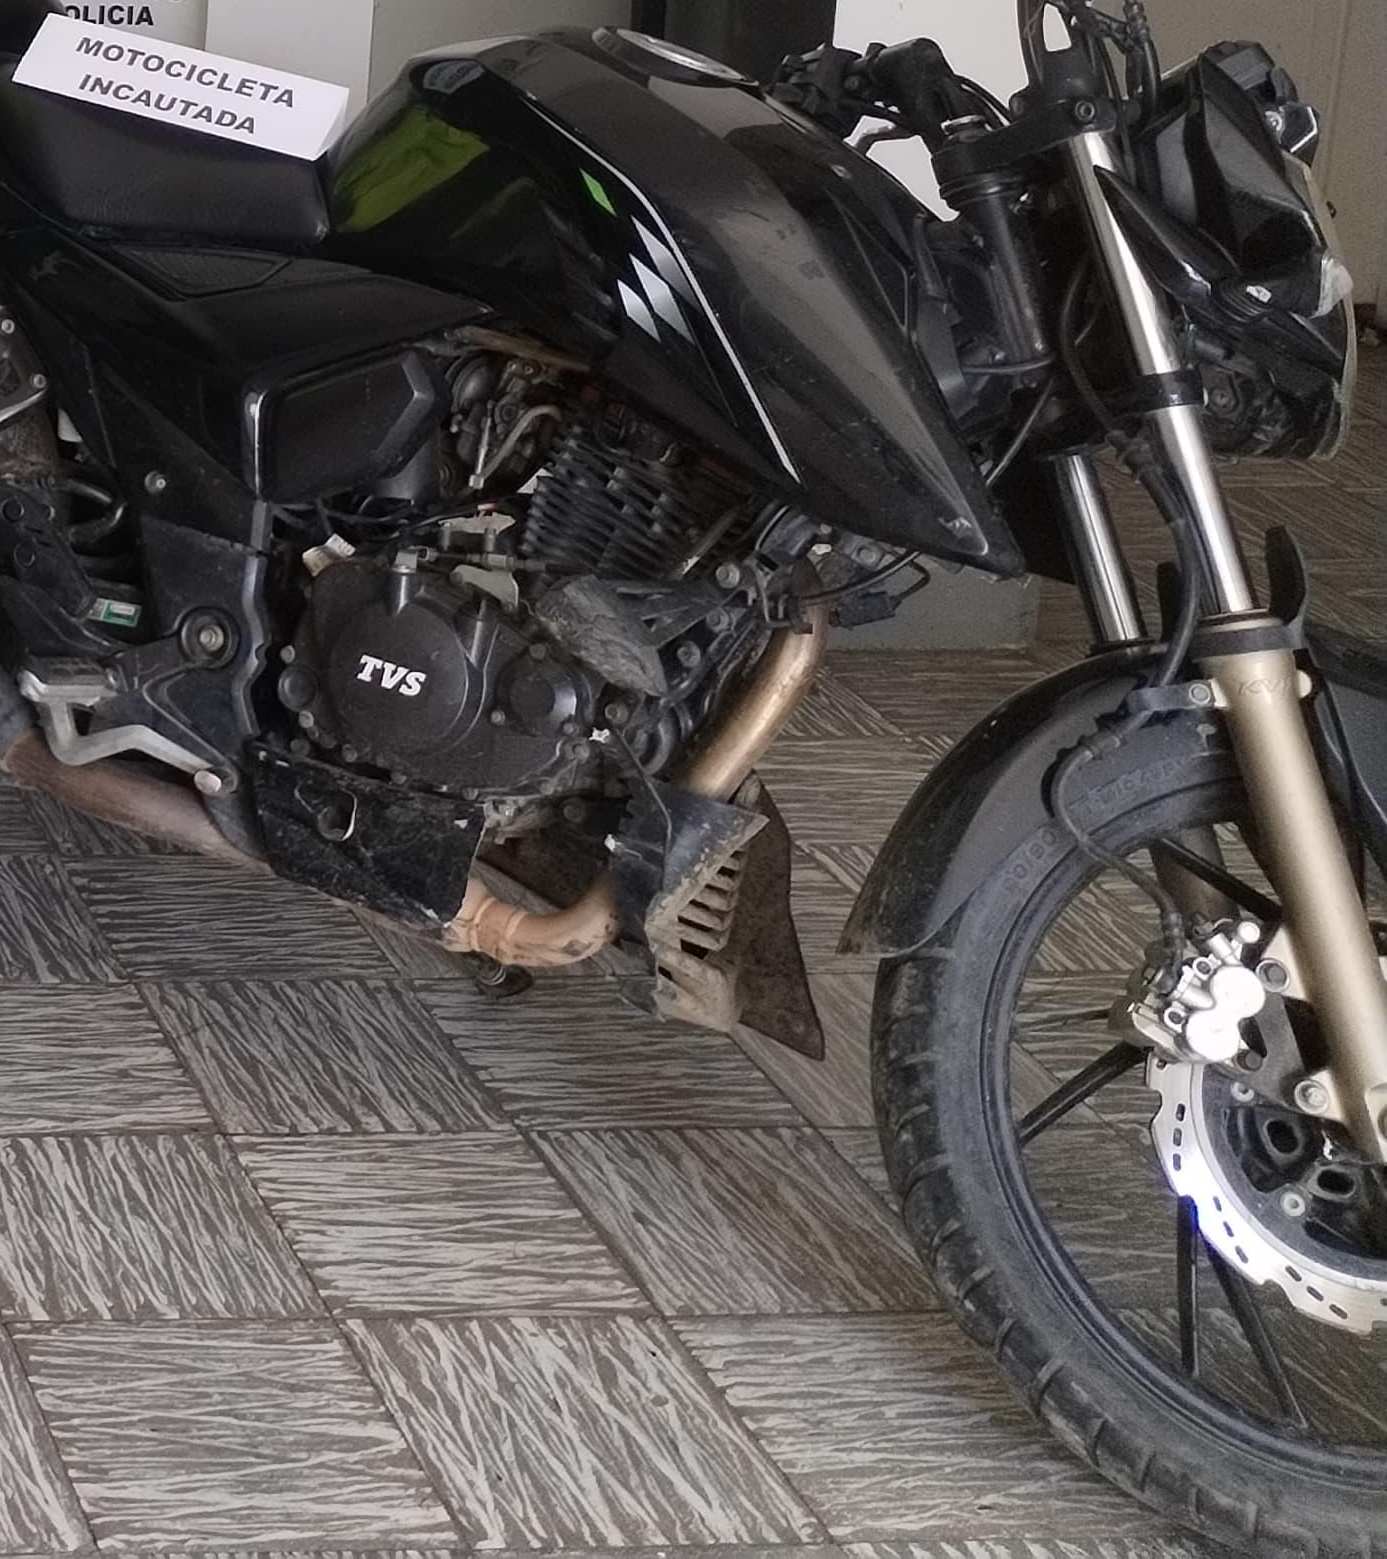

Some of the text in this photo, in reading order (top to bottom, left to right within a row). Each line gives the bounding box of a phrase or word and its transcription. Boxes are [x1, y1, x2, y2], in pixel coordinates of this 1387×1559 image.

[75, 36, 295, 108] MOTOCICLETA
[78, 73, 256, 135] INCAUTADA
[355, 653, 428, 697] TVS
